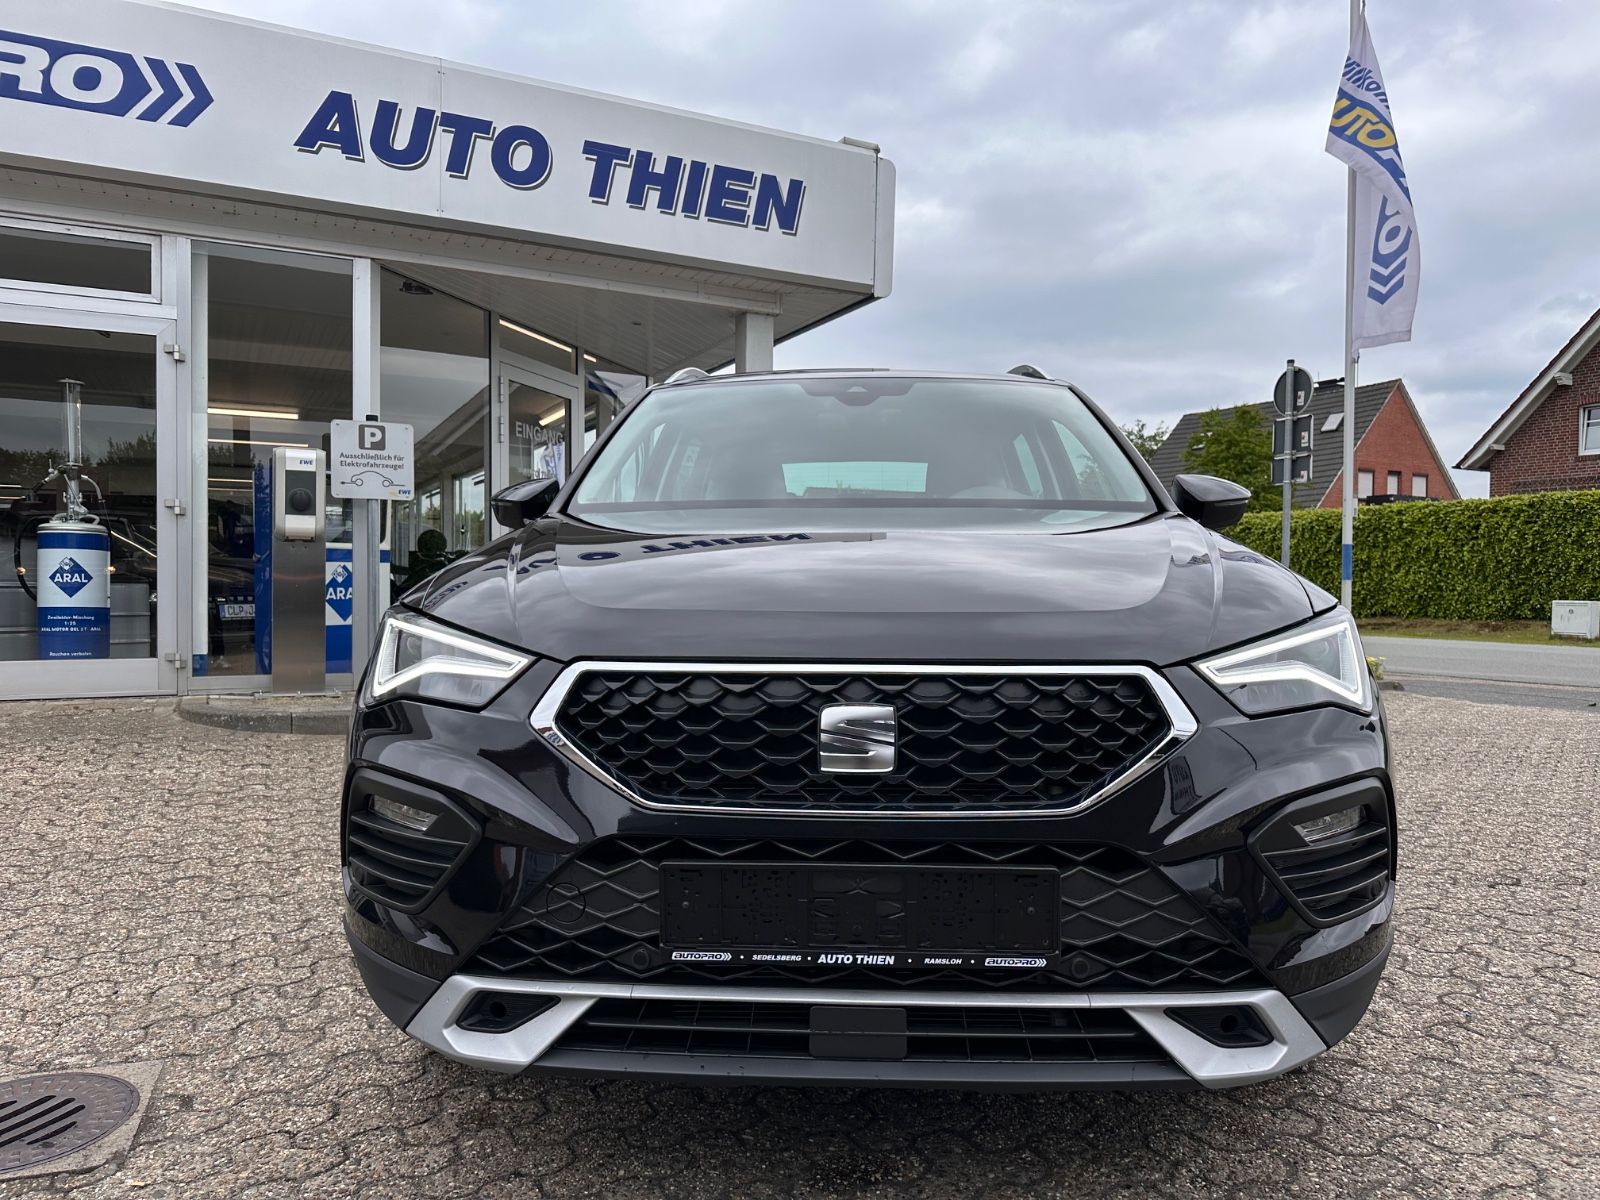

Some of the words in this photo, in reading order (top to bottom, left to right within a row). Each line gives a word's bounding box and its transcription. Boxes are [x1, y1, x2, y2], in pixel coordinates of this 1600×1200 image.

[293, 90, 552, 190] AUTO
[582, 140, 806, 236] THIEN
[364, 427, 383, 449] P
[515, 421, 565, 445] EINGANG
[339, 452, 393, 461] Ausschließlich
[340, 460, 404, 470] Elektrofahrzeuge!
[53, 573, 89, 583] ARAL
[752, 954, 802, 962] SEDELSBERG
[817, 954, 853, 965] AUTO
[855, 954, 895, 965] THIEN
[924, 957, 963, 965] RAMSLOH
